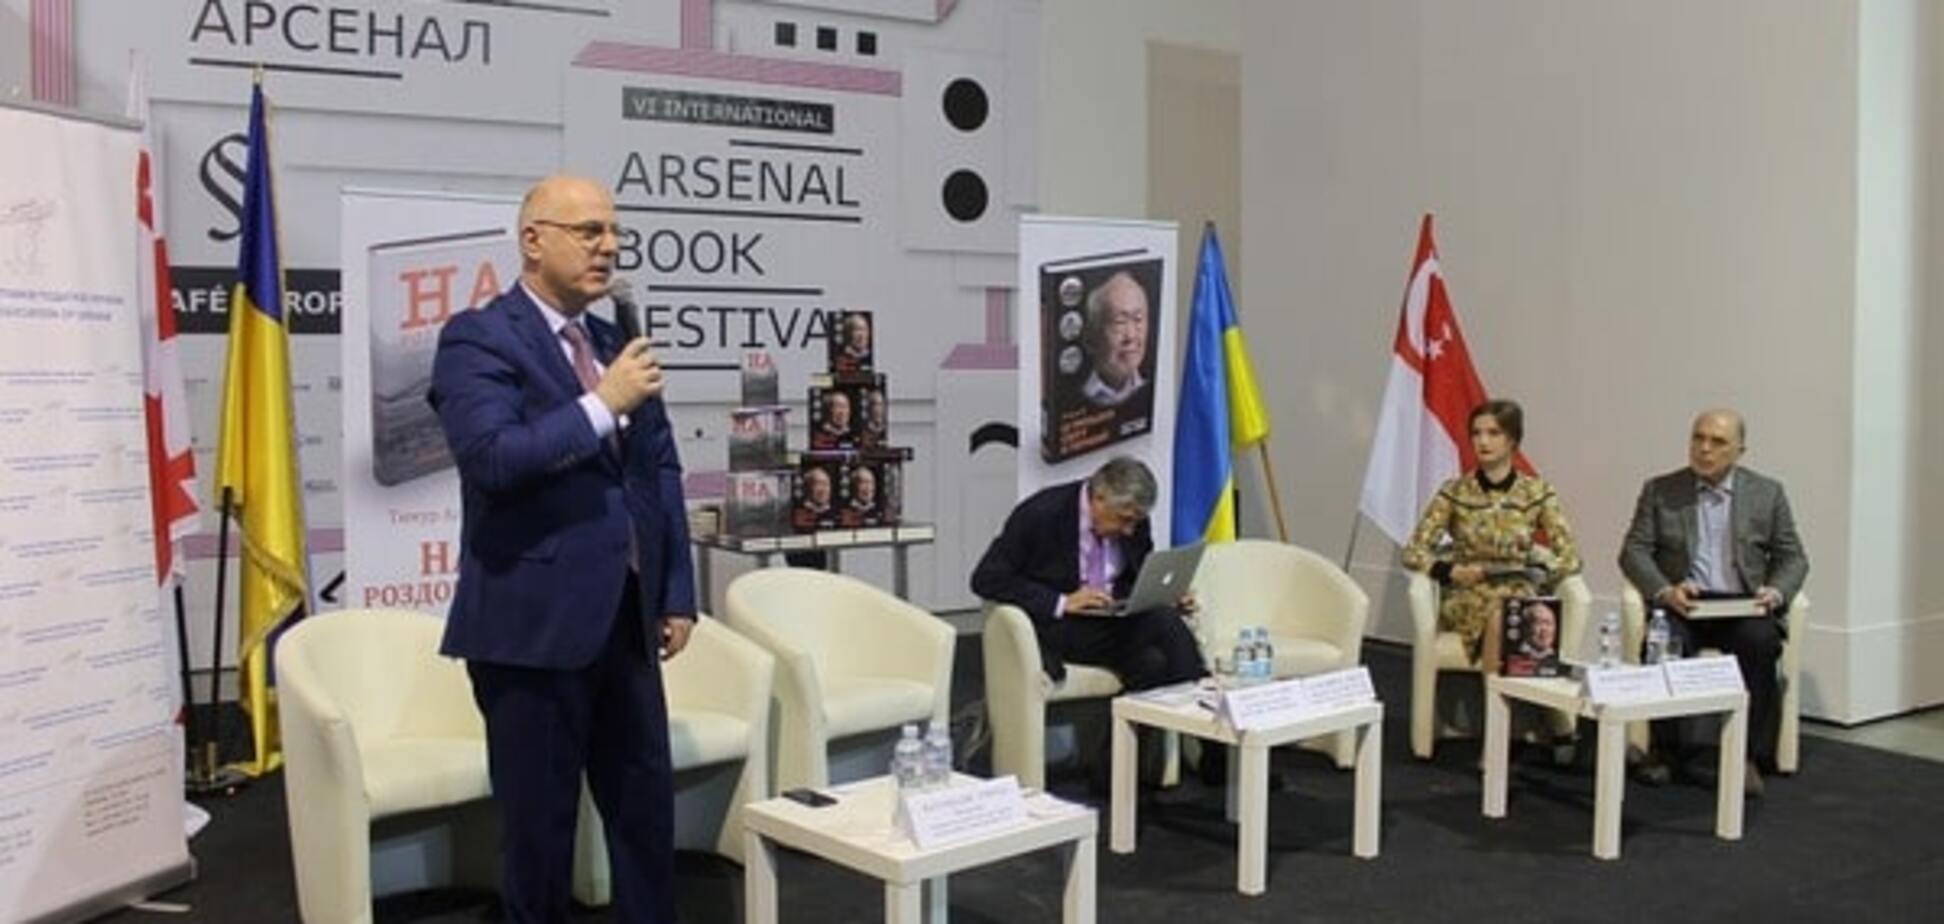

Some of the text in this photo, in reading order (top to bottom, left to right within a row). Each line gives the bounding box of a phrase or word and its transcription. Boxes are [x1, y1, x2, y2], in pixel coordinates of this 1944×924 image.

[190, 0, 491, 65] АРСЕНАЛ
[632, 97, 828, 127] VI INTERNATIONAL
[615, 152, 861, 208] ARSENAL
[614, 229, 765, 275] BOOK
[171, 283, 229, 313] AFÉ
[645, 305, 829, 348] ESTIVA
[363, 581, 452, 609] РОЗДО
